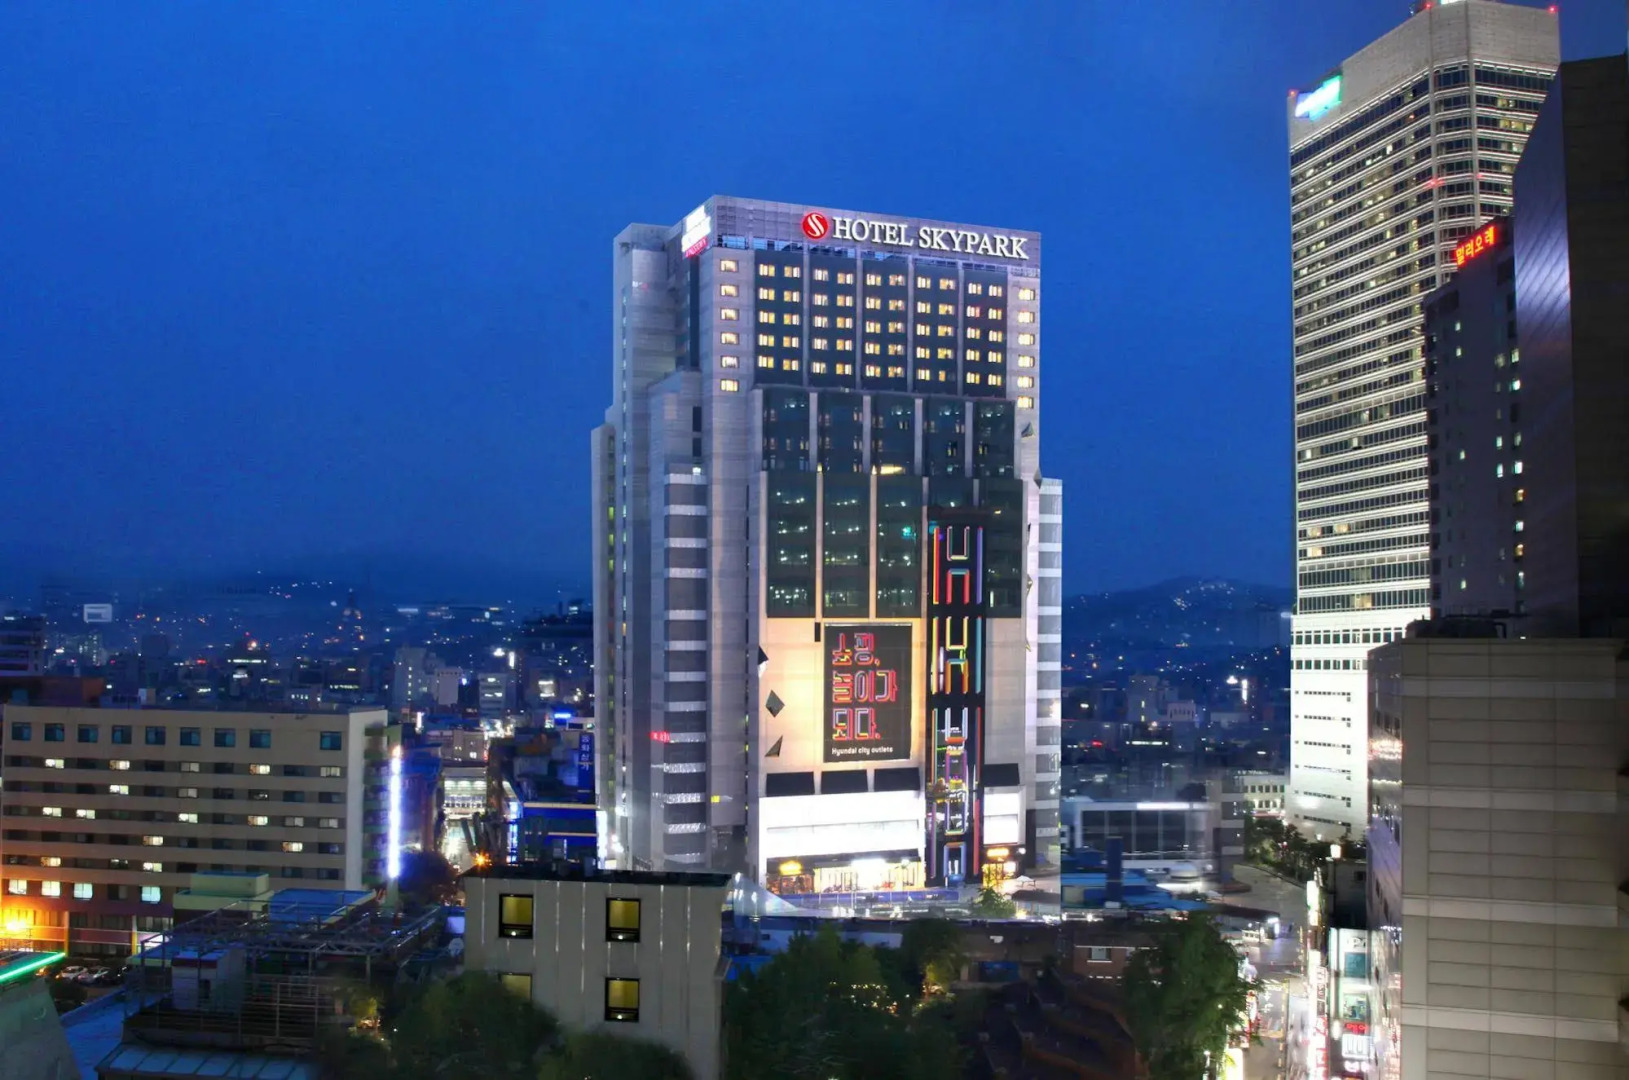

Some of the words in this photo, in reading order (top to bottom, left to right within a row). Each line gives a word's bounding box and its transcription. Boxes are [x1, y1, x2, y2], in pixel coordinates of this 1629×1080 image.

[832, 216, 914, 247] HOTEL
[918, 226, 1029, 260] SKYPARK
[1455, 226, 1495, 266] 밀리오레
[831, 669, 898, 704] 놀이가
[831, 707, 881, 741] 되다.
[831, 747, 857, 757] Hyundai
[858, 746, 870, 756] city
[871, 746, 894, 754] outlets
